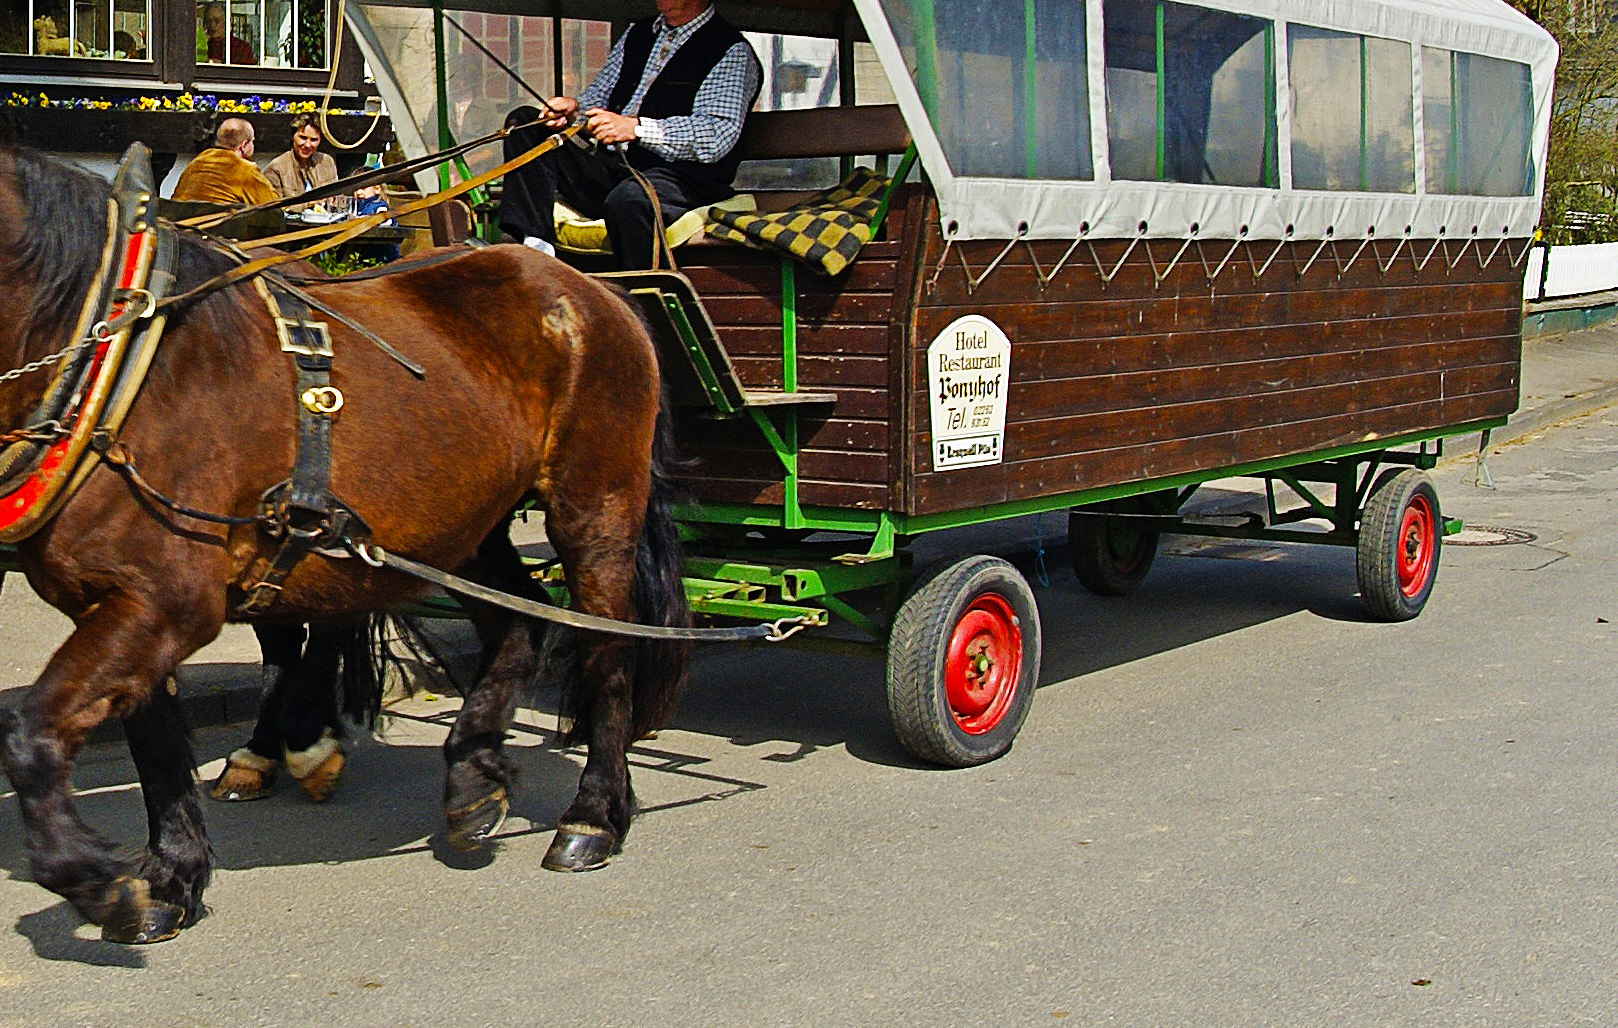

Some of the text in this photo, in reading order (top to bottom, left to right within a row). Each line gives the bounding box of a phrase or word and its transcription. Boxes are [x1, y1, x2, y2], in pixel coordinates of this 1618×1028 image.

[955, 330, 988, 351] Hotel
[938, 352, 1002, 373] Restaurant
[938, 374, 1002, 405] Ponyhof
[946, 406, 967, 431] Tel.
